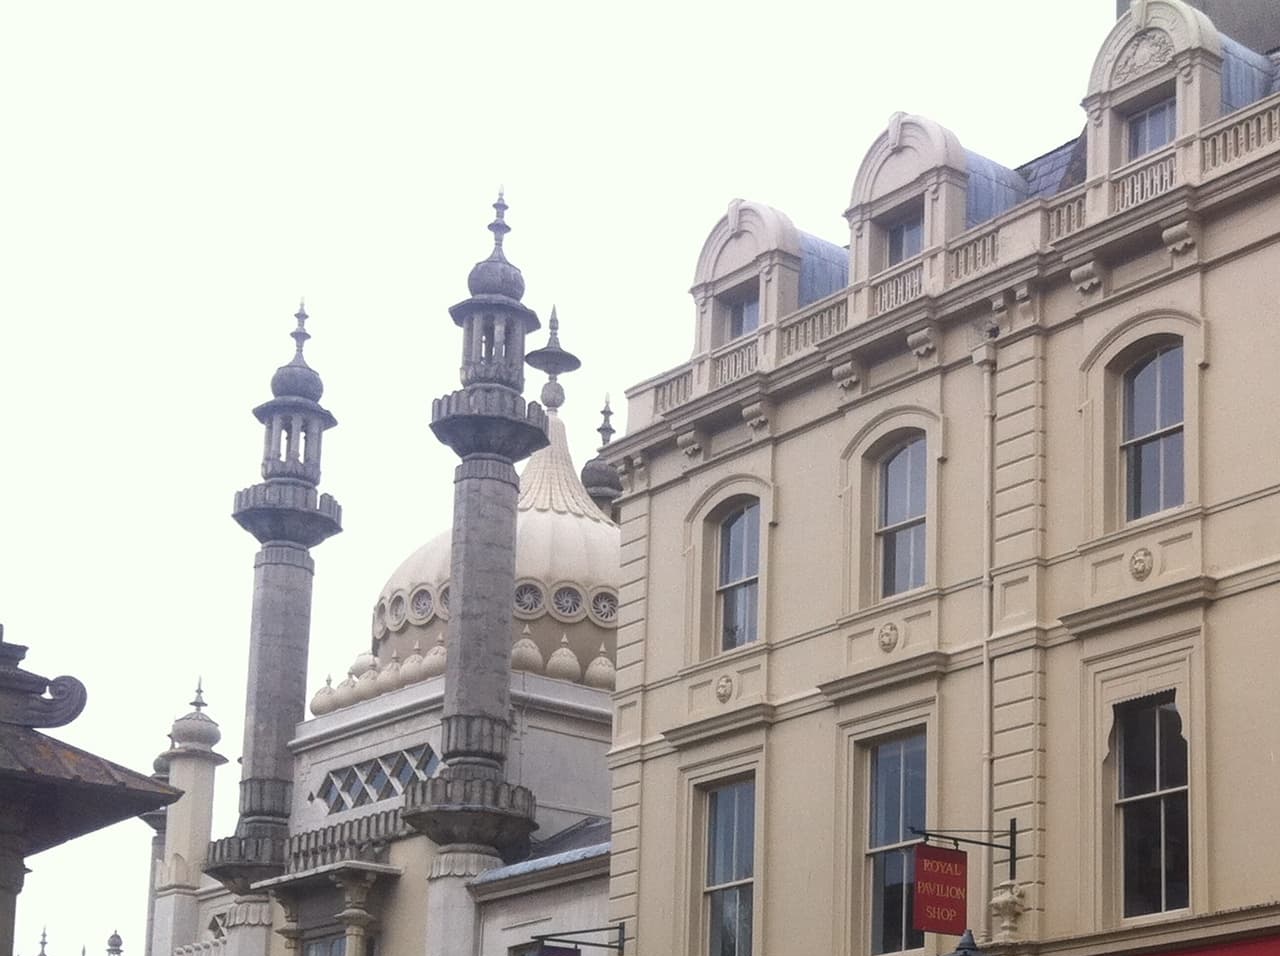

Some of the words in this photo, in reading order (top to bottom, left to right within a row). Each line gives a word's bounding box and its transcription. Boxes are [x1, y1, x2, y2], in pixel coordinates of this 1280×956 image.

[923, 859, 962, 876] ROYAL
[917, 881, 966, 900] PAVILION
[926, 905, 957, 921] SHOP
